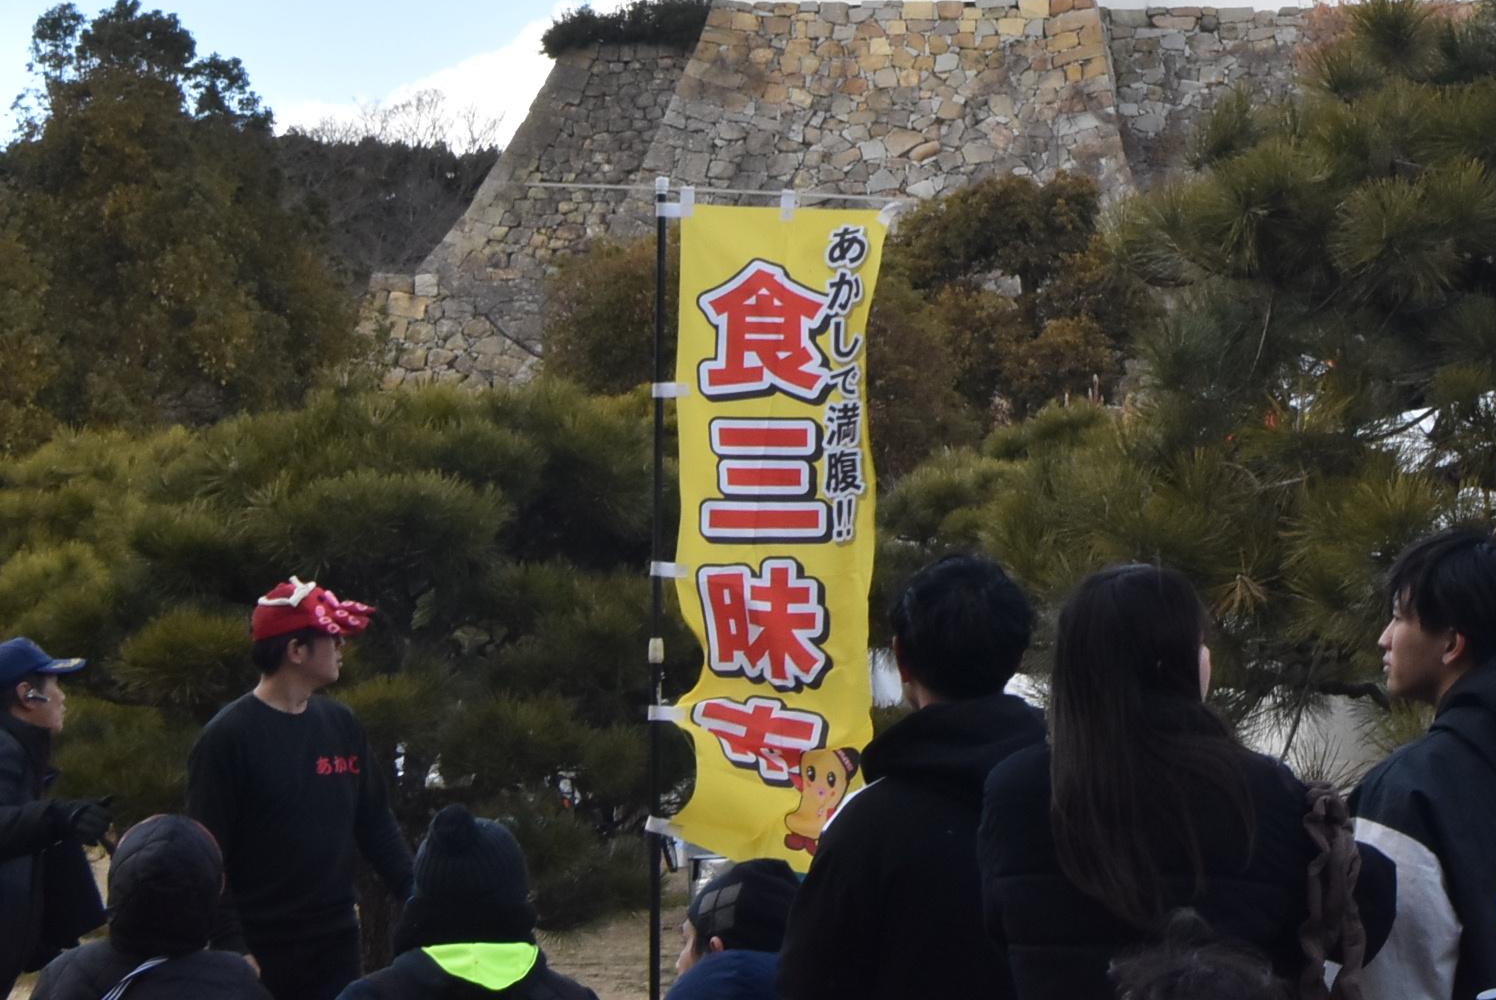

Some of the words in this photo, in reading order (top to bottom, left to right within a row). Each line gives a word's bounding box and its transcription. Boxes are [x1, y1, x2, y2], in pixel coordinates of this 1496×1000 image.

[824, 225, 867, 541] あかしで満腹!!
